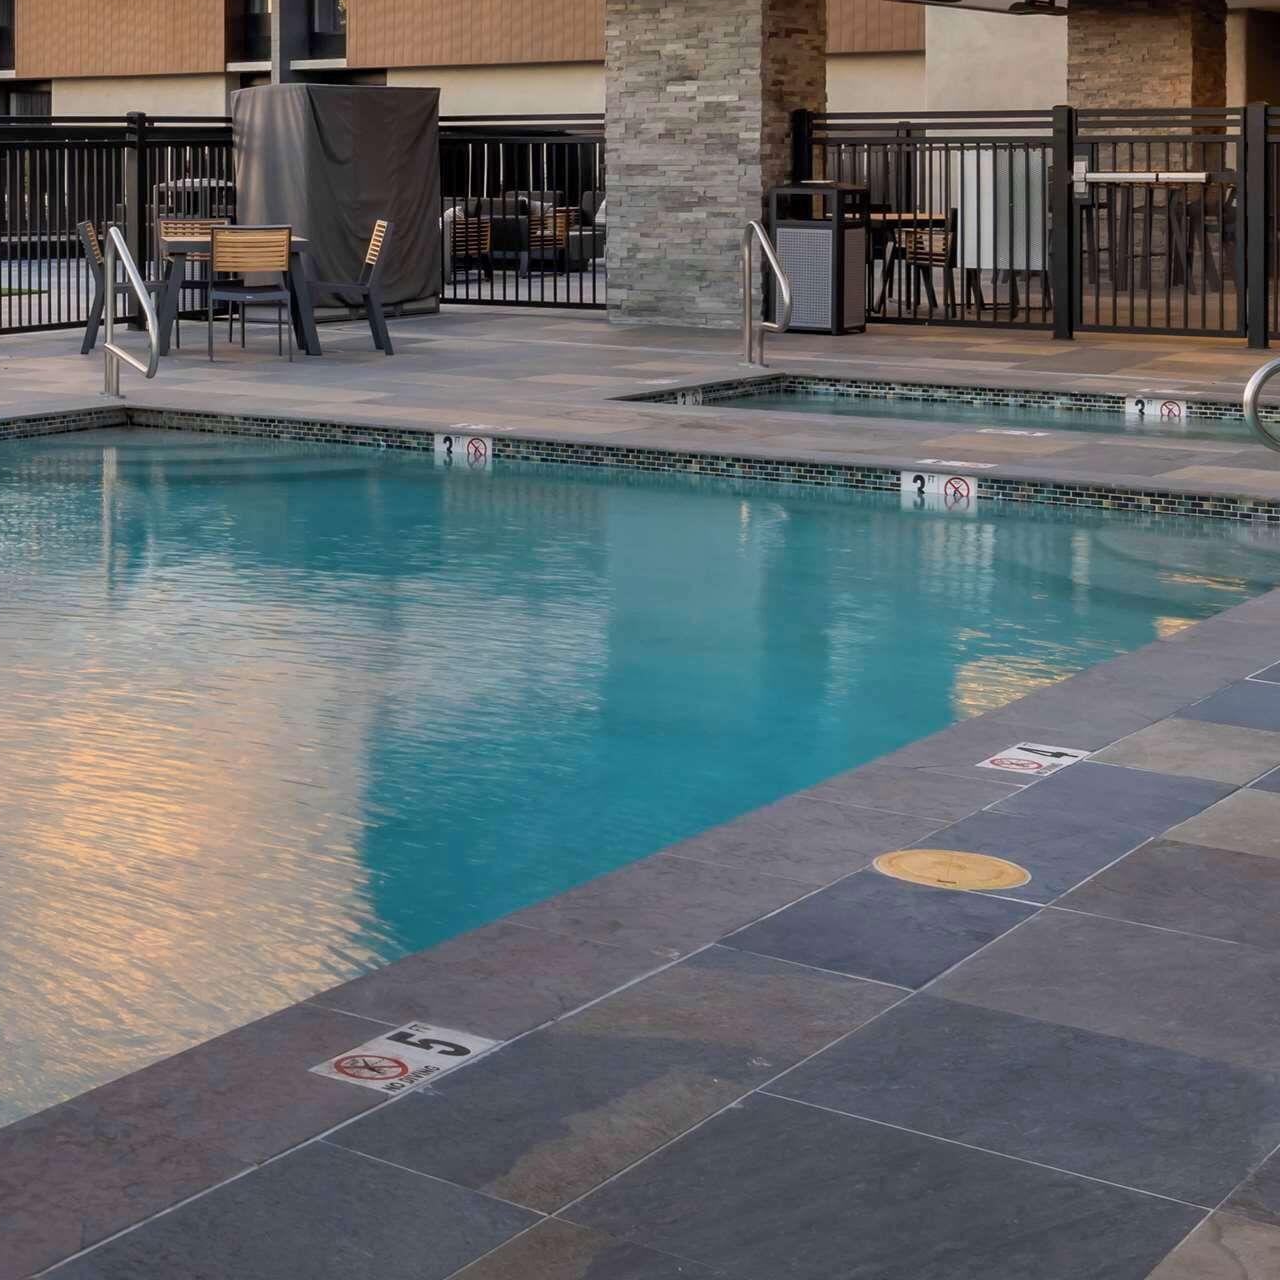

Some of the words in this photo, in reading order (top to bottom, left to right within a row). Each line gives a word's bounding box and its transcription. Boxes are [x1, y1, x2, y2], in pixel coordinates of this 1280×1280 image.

[386, 1031, 471, 1057] 5
[382, 1079, 405, 1093] NO
[400, 1064, 440, 1085] DIVING
